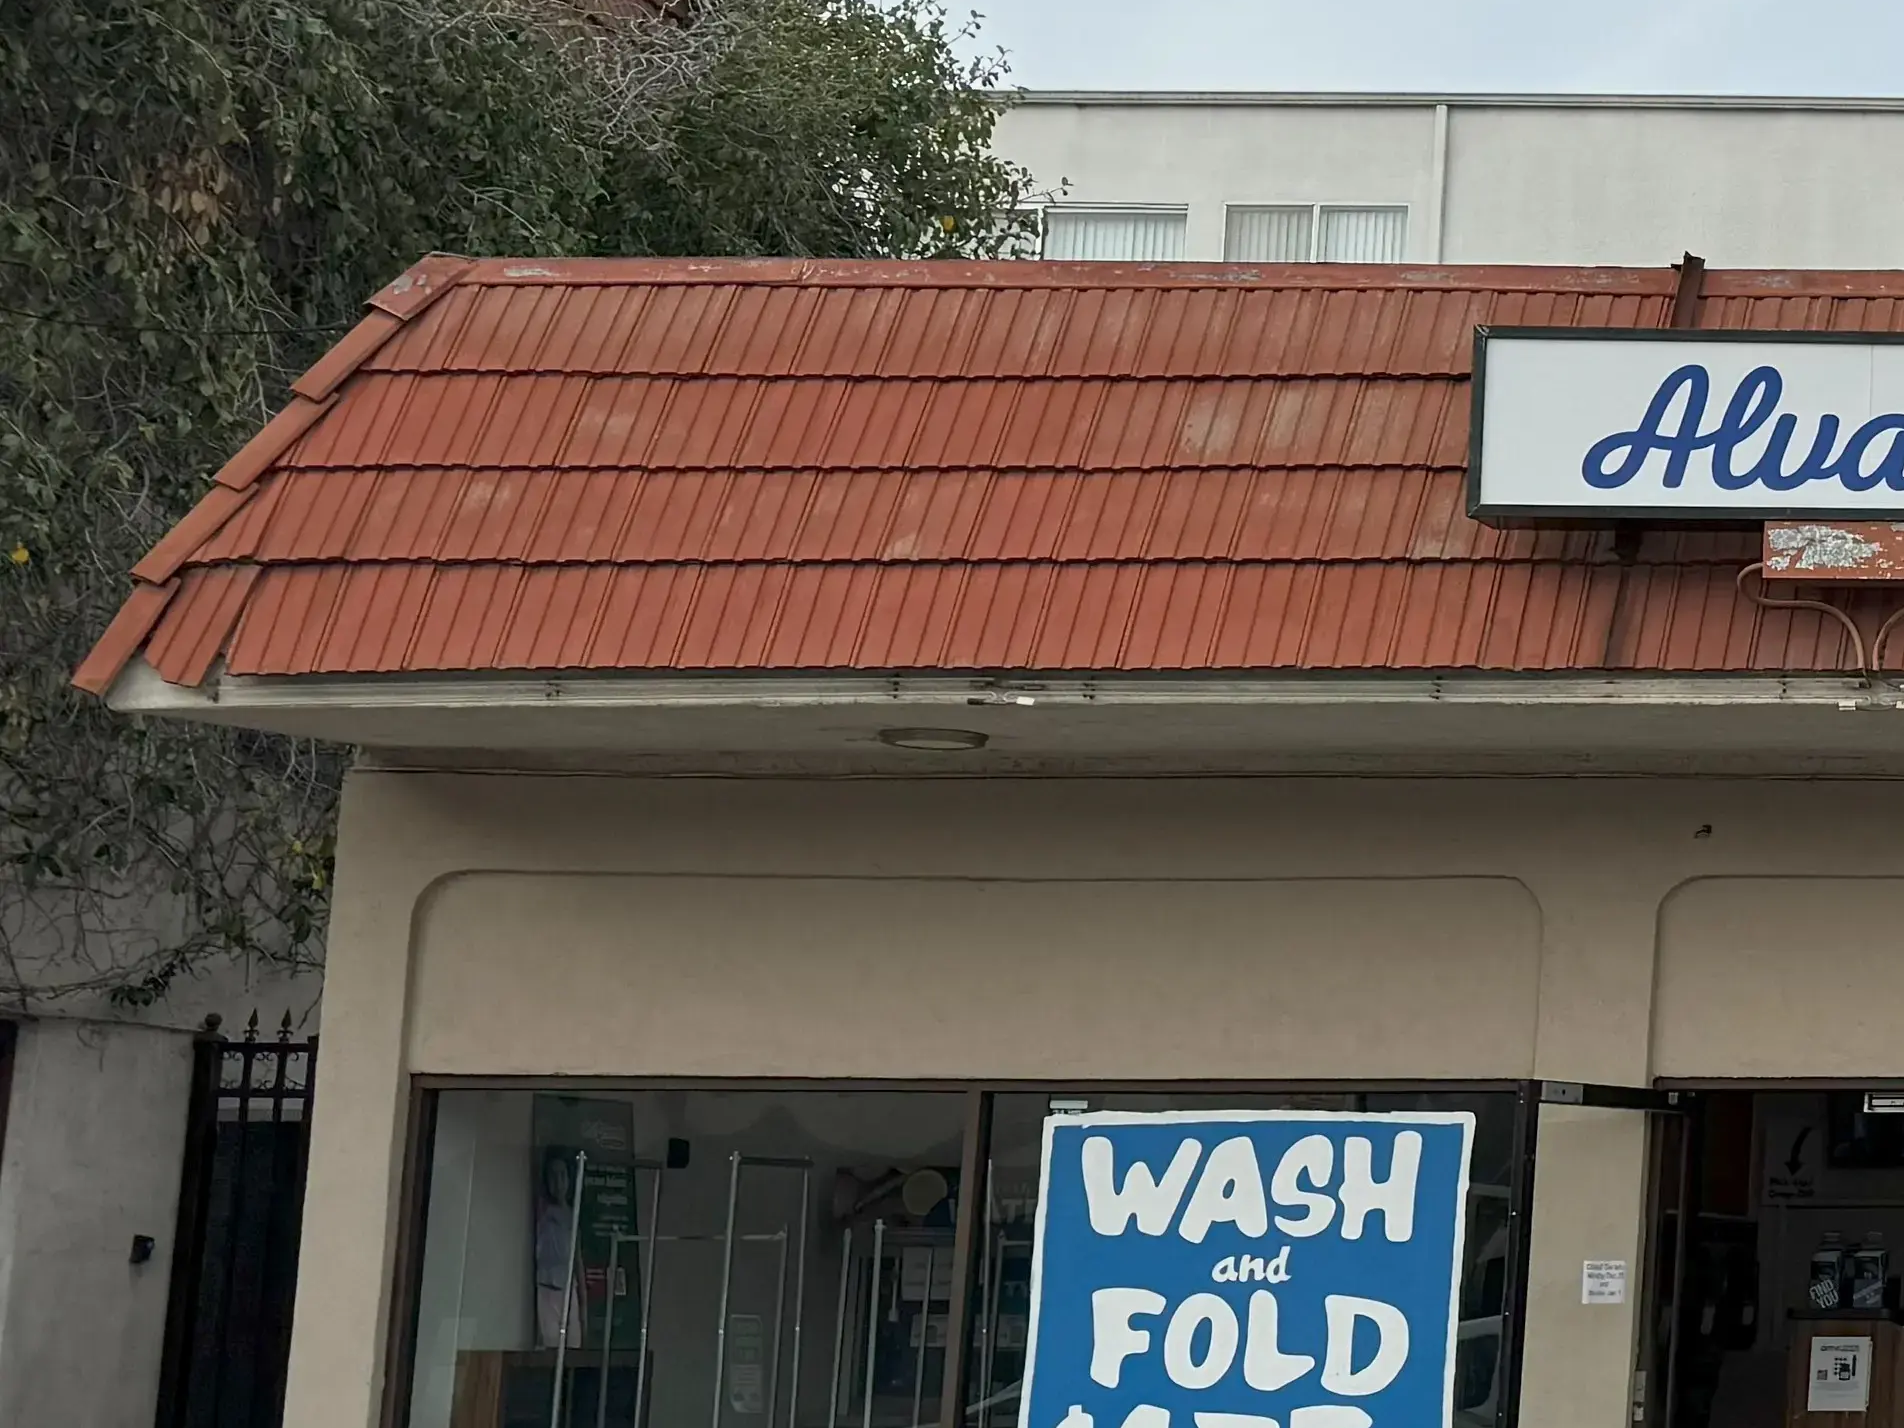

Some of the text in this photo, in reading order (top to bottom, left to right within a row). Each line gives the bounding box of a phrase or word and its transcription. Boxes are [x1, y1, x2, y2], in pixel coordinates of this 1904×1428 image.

[1081, 1130, 1423, 1244] WASH
[1211, 1246, 1291, 1283] and
[1089, 1287, 1410, 1396] FOLD
